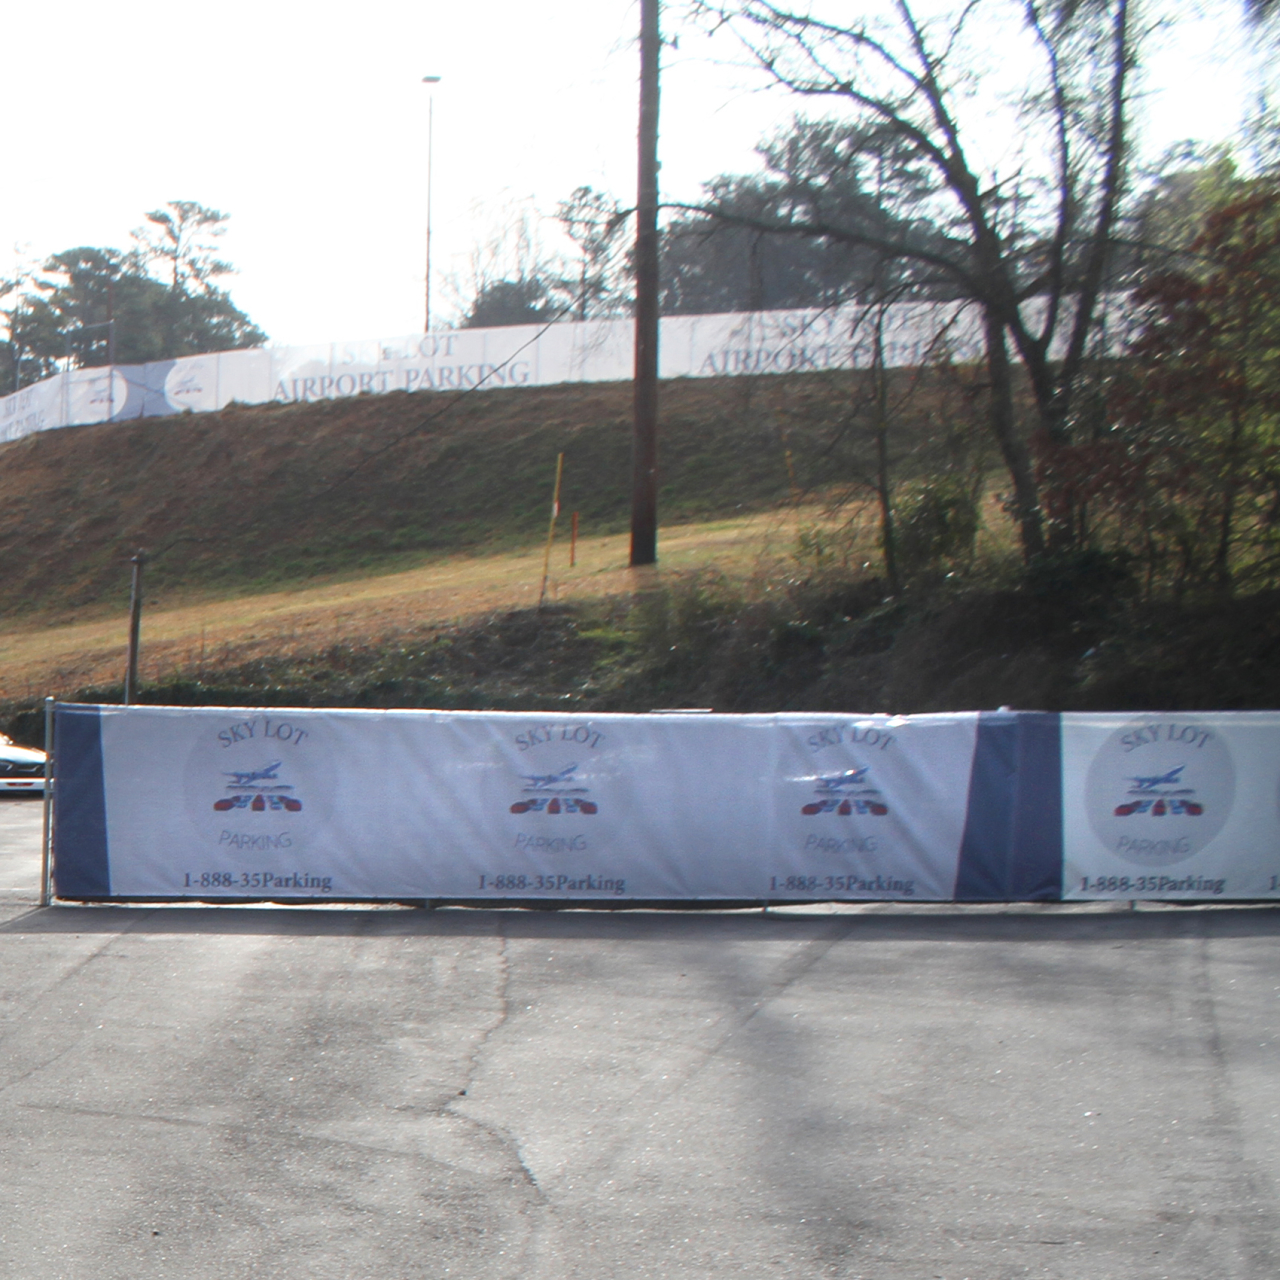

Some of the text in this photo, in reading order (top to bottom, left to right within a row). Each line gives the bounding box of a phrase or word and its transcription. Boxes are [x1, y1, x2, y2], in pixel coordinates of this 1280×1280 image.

[272, 361, 531, 402] AIRPORT PARKING
[217, 719, 309, 750] SKY LOT
[515, 723, 606, 753] SKY LOT
[807, 726, 897, 753] SKY LOT
[1121, 723, 1215, 753] SKY LOT
[218, 829, 292, 851] PARKING
[183, 870, 333, 892] 1-888-35Parking
[478, 873, 626, 894] 1-888-35Parking
[769, 873, 915, 895] 1-888-35Parking
[1079, 875, 1227, 894] 1-888-35Parking
